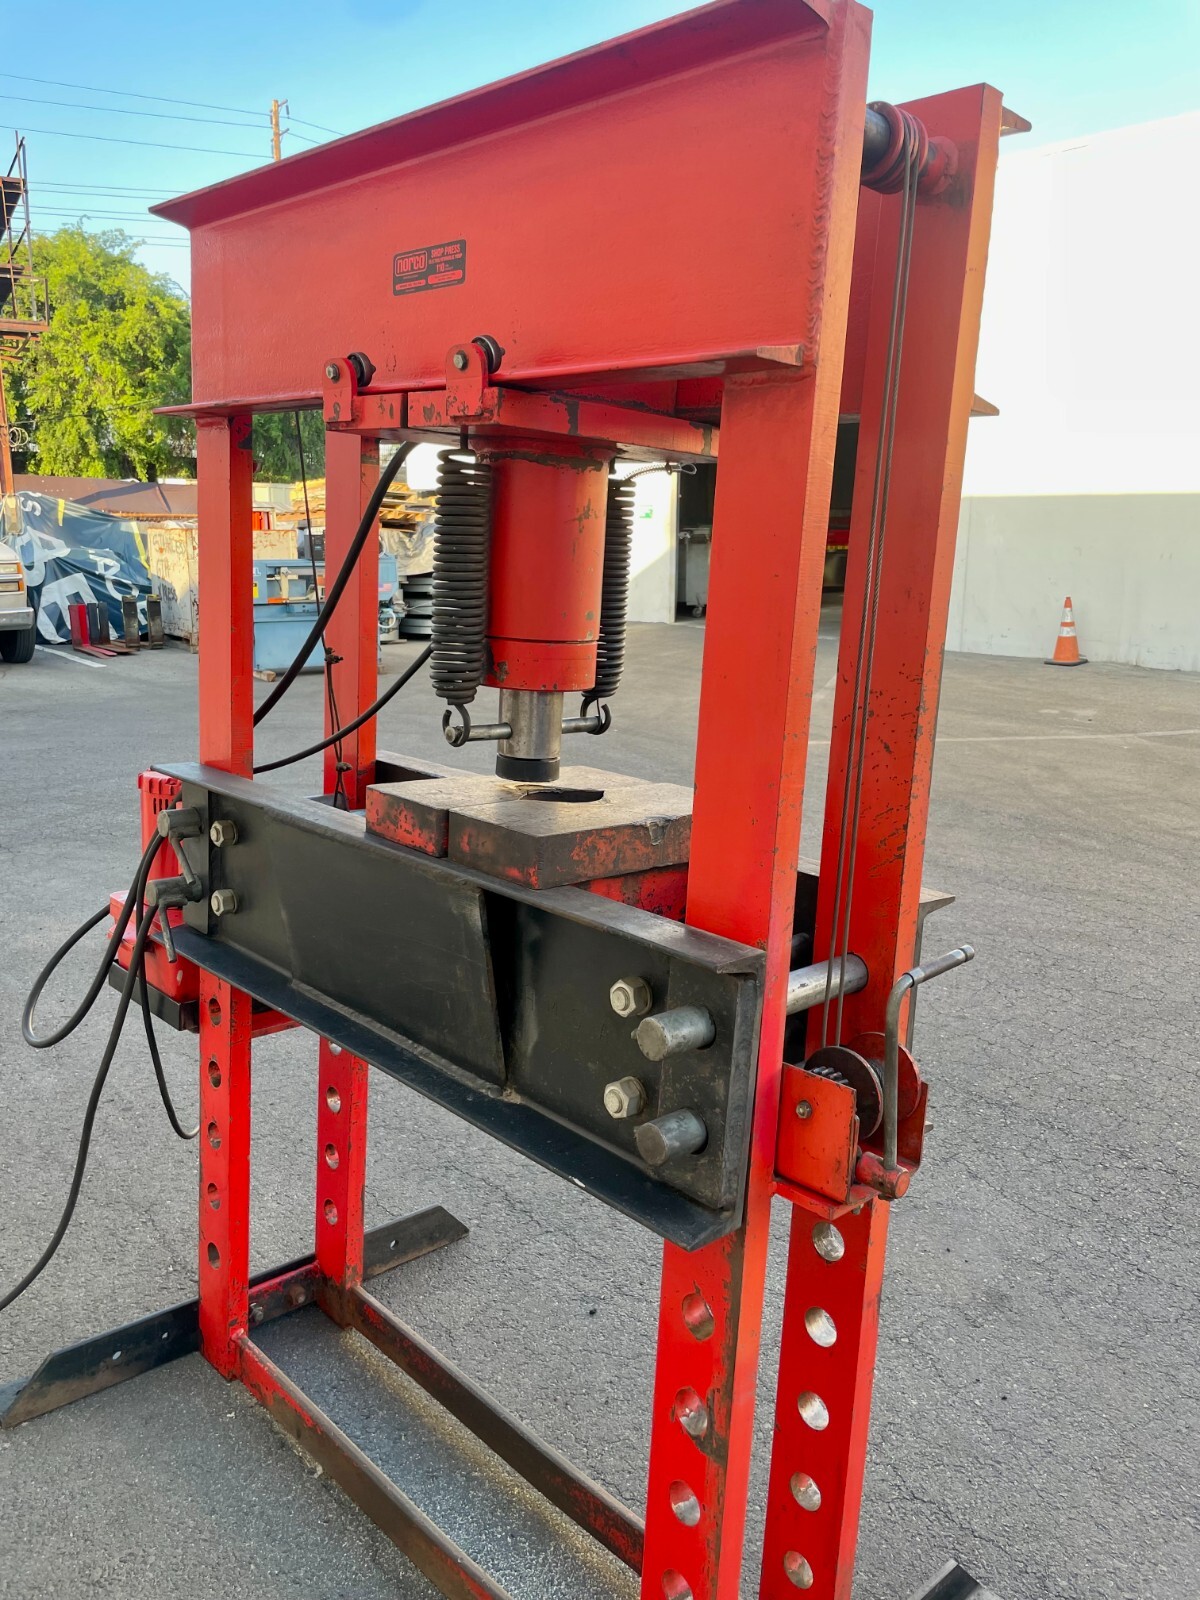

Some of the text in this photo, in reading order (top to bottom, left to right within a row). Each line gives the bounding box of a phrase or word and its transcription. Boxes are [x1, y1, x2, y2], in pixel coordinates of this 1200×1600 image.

[431, 244, 460, 258] SHOP PRESS
[397, 255, 425, 274] norco
